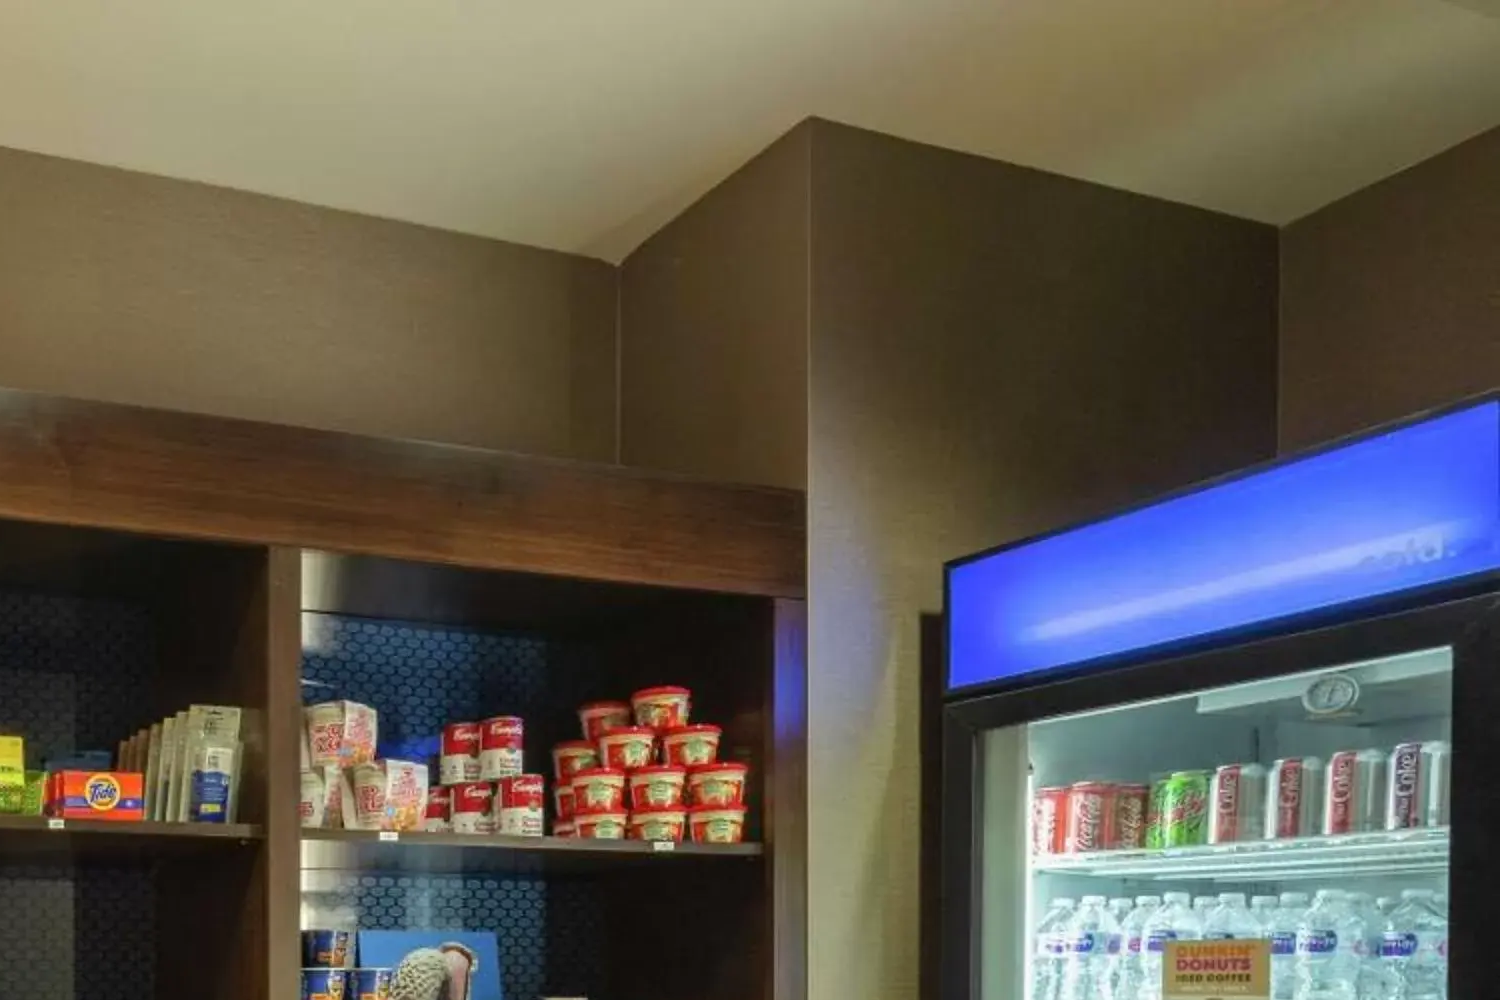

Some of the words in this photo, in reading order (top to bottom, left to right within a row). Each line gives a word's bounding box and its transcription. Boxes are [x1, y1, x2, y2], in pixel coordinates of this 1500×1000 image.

[89, 781, 118, 802] Tide
[1176, 959, 1251, 971] DONUTS
[1206, 973, 1251, 982] COFFEE
